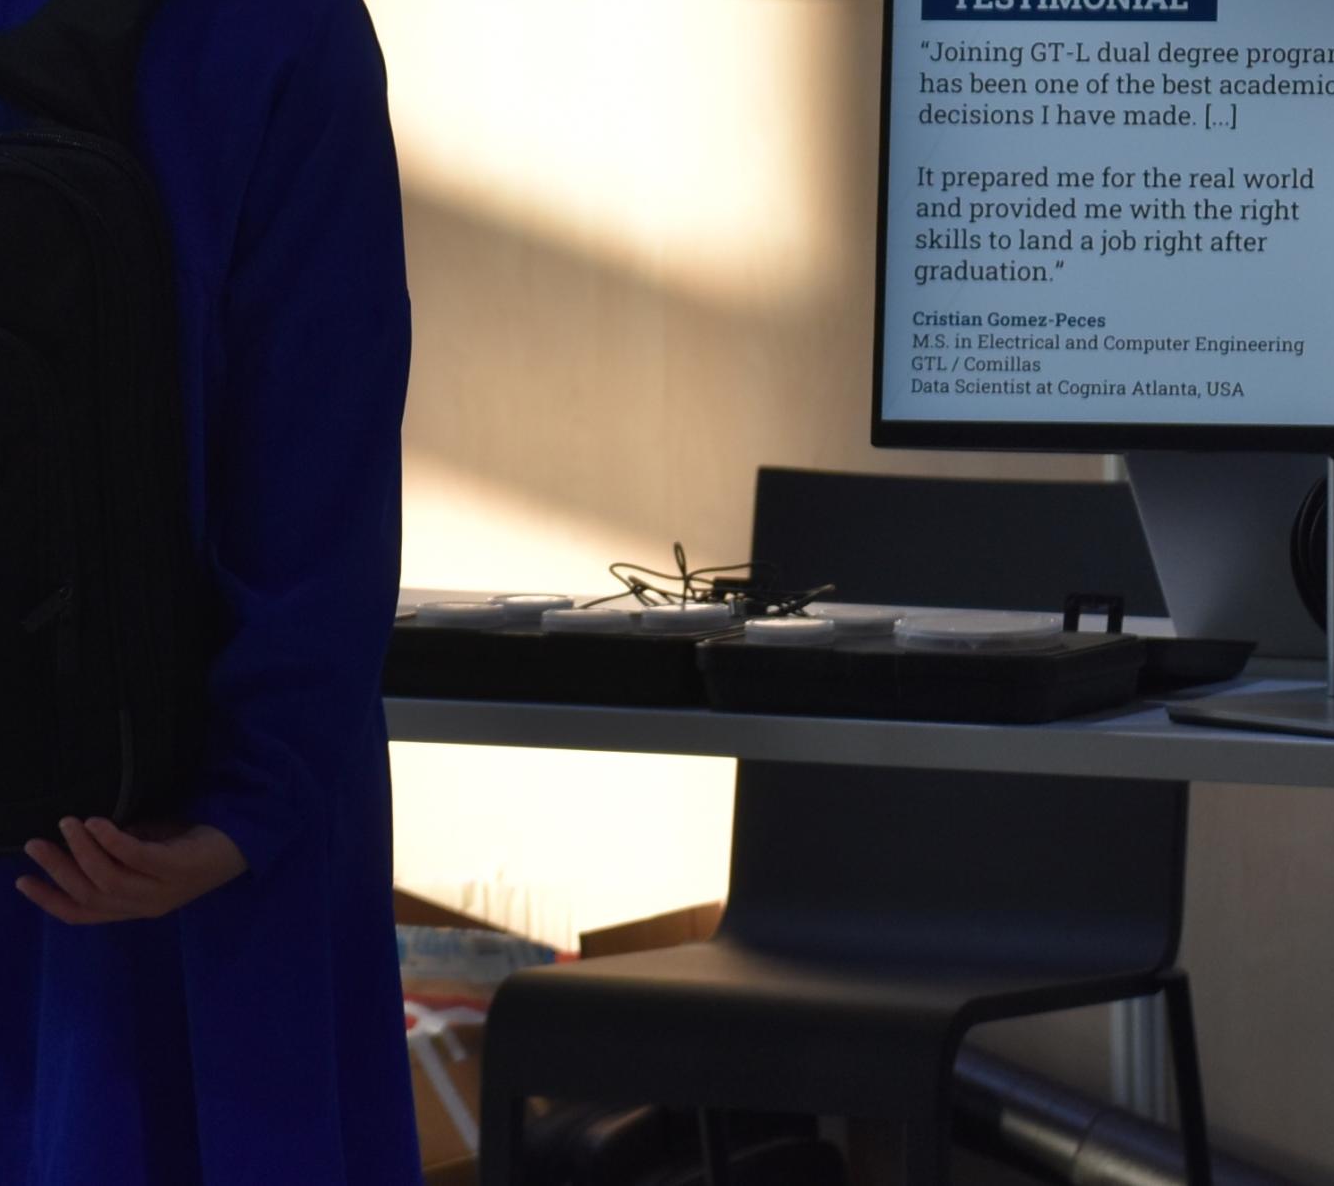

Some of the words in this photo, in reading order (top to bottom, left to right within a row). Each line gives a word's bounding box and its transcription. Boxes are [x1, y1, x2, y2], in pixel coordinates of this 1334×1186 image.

[1029, 41, 1090, 63] GT-L
[1096, 40, 1150, 63] dual
[1157, 40, 1239, 68] degree
[918, 71, 963, 94] has
[968, 71, 1027, 94] been
[1034, 77, 1079, 94] one
[1085, 71, 1110, 94] of
[1115, 72, 1155, 95] the
[1161, 72, 1212, 95] best
[917, 102, 1034, 126] decisions
[1040, 104, 1049, 125] I
[1055, 102, 1116, 126] have
[1122, 103, 1196, 126] made.
[916, 165, 934, 187] It
[940, 165, 1049, 193] prepared
[1056, 171, 1095, 188] me
[1101, 165, 1136, 188] for
[1141, 165, 1182, 189] the
[1188, 166, 1235, 189] real
[1242, 166, 1315, 190] world
[915, 195, 962, 218] and
[968, 196, 1077, 224] provided
[1083, 202, 1122, 219] me
[1128, 197, 1186, 220] with
[1192, 197, 1233, 221] the
[1239, 197, 1299, 226] right
[914, 227, 981, 250] skills
[987, 230, 1011, 250] to
[1018, 227, 1073, 251] land
[1079, 234, 1094, 251] a
[1099, 228, 1136, 256] job
[1143, 229, 1203, 257] right
[1209, 229, 1268, 253] after
[911, 309, 983, 327] Cristian
[986, 311, 1106, 328] Gomez-Peces
[911, 332, 949, 349] M.S.
[953, 332, 972, 350] in
[976, 332, 1060, 350] Electrical
[1064, 333, 1098, 350] and
[1102, 334, 1190, 355] Computer
[1194, 334, 1305, 357] Engineering
[910, 354, 948, 372] GTL
[950, 355, 960, 372] /
[963, 355, 1041, 373] Comillas
[910, 377, 949, 394] Data
[954, 377, 1031, 395] Scientist
[1035, 380, 1053, 395] at
[1057, 378, 1126, 399] Cognira
[1130, 379, 1201, 399] Atlanta,
[1205, 380, 1245, 397] USA
